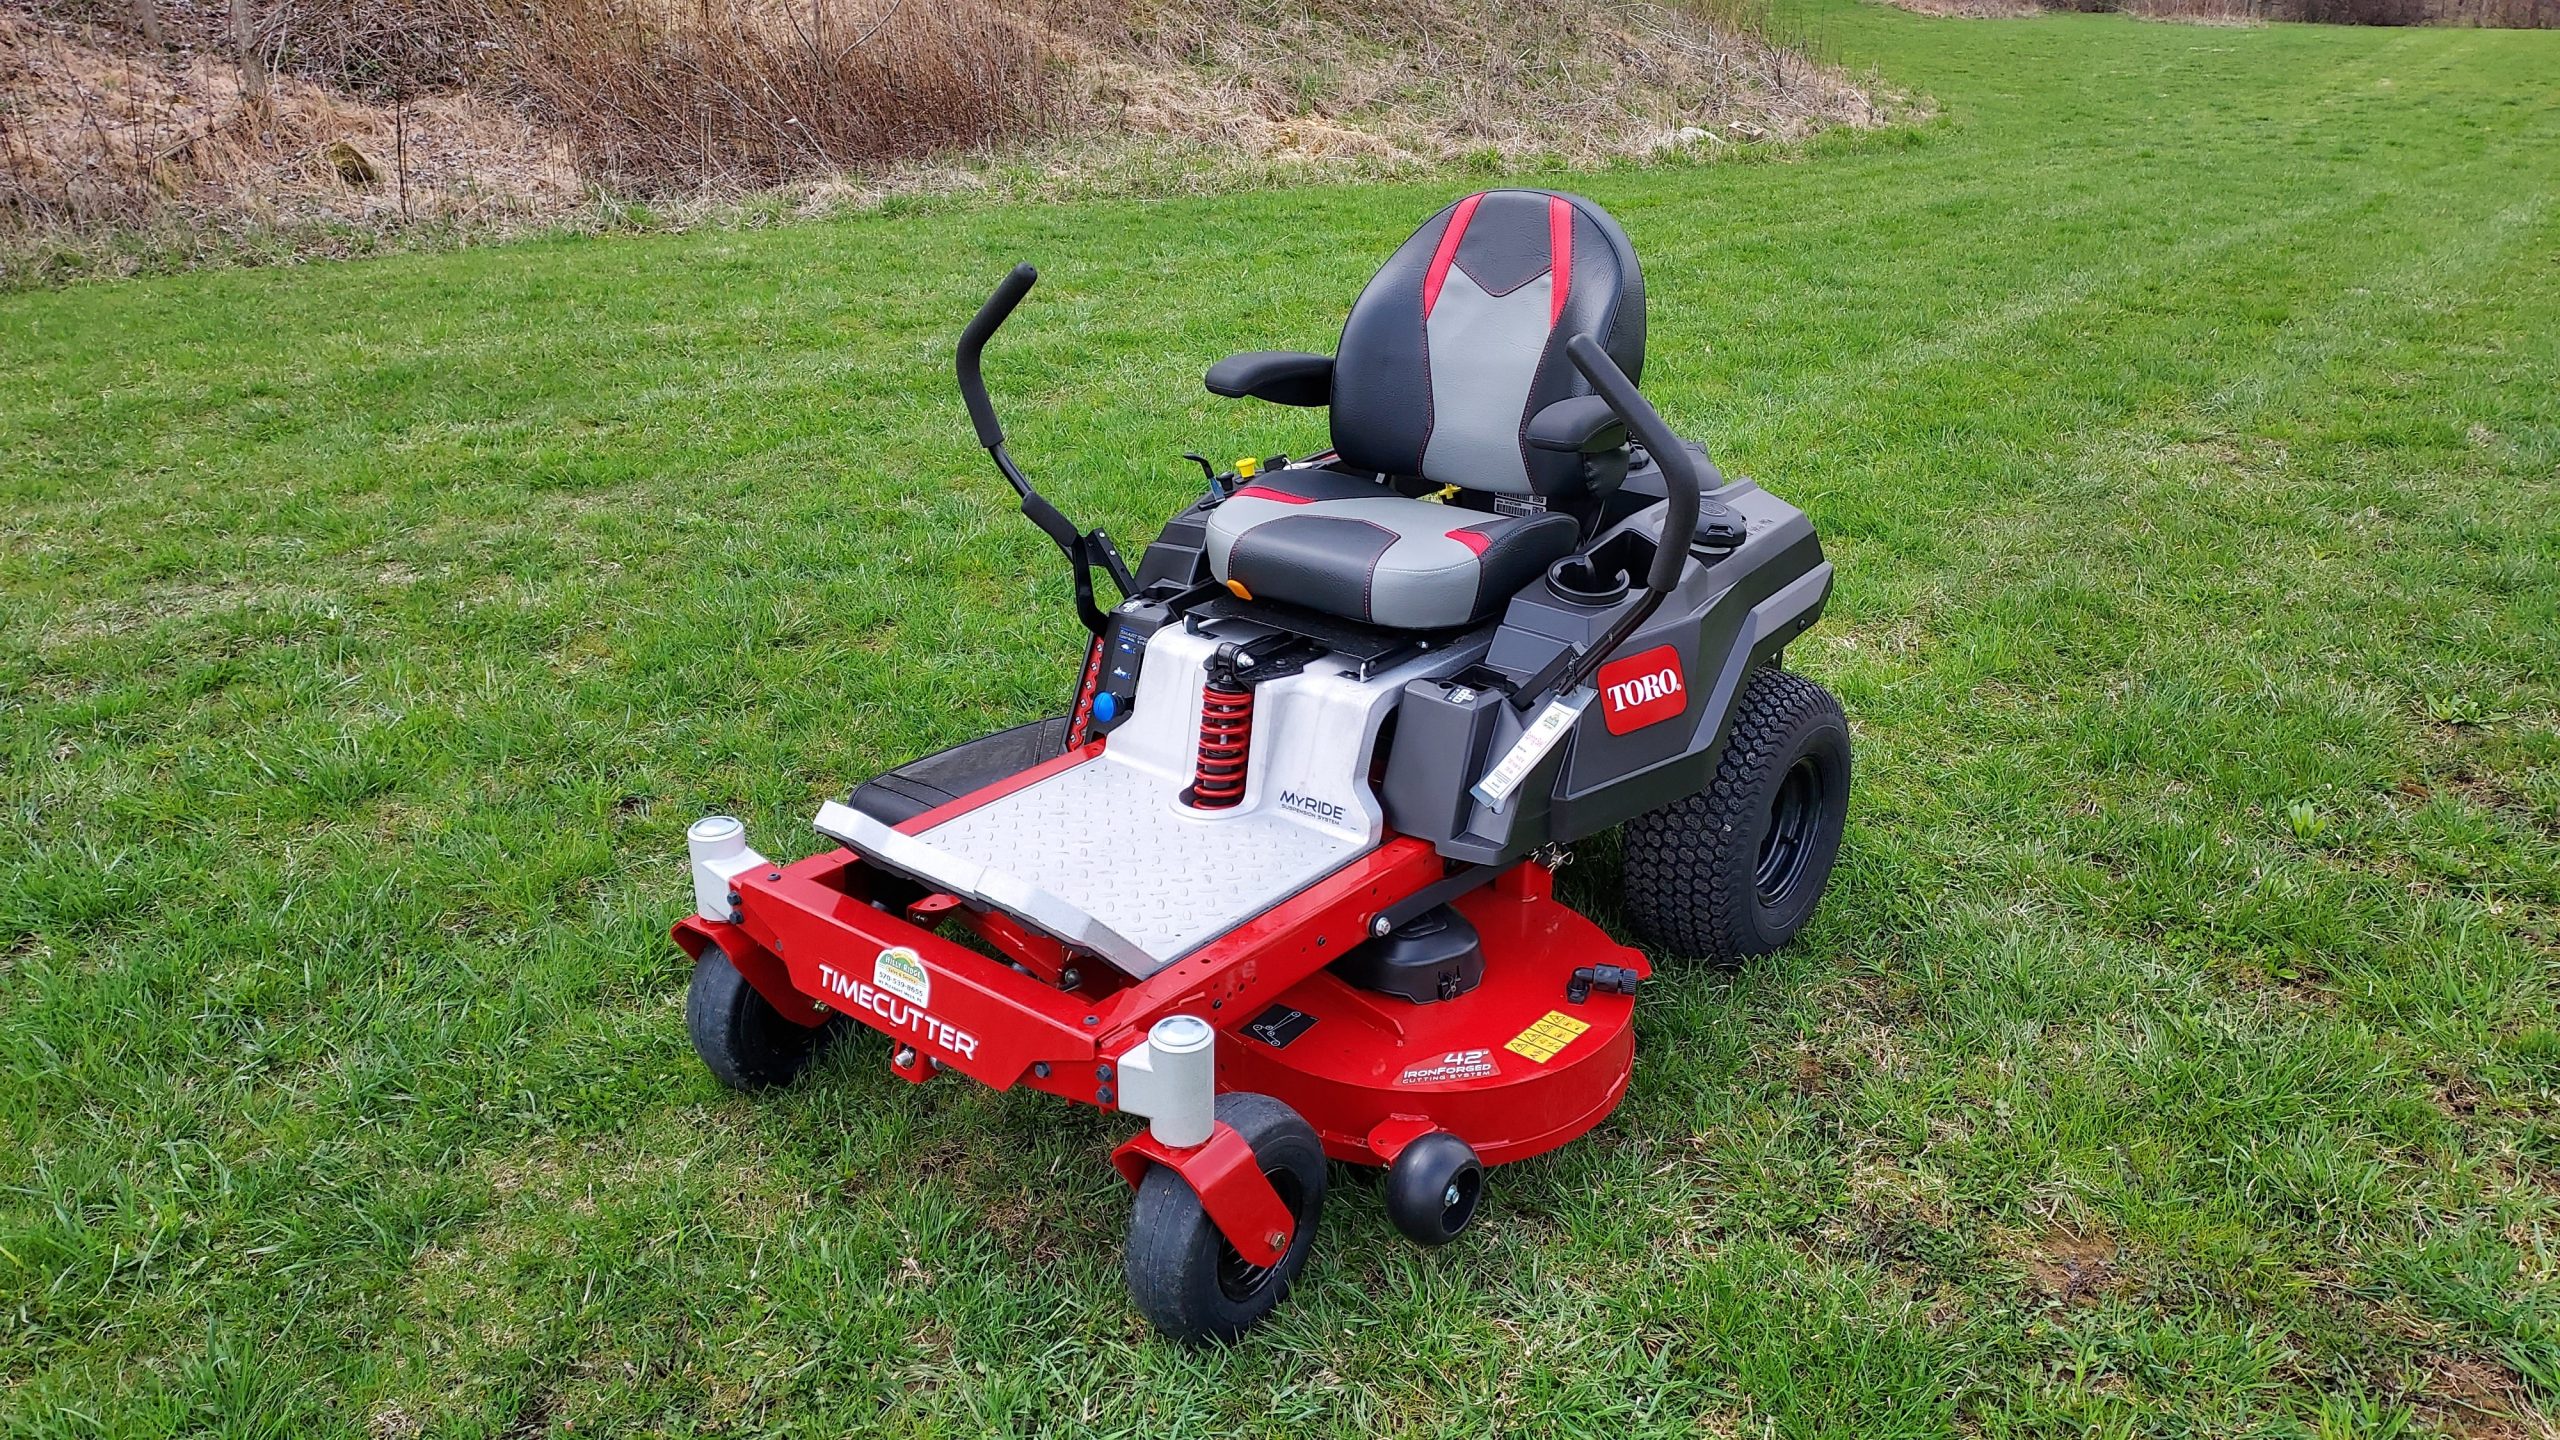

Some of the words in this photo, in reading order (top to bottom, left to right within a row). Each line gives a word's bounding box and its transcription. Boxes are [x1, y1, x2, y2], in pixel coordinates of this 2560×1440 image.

[1281, 803, 1316, 818] SUSPENSION
[1317, 815, 1340, 825] SYSTEM
[885, 955, 902, 969] HILLY
[903, 963, 921, 979] RIDGE
[1402, 1074, 1446, 1084] CUTTING
[1449, 1071, 1490, 1080] SYSTEM
